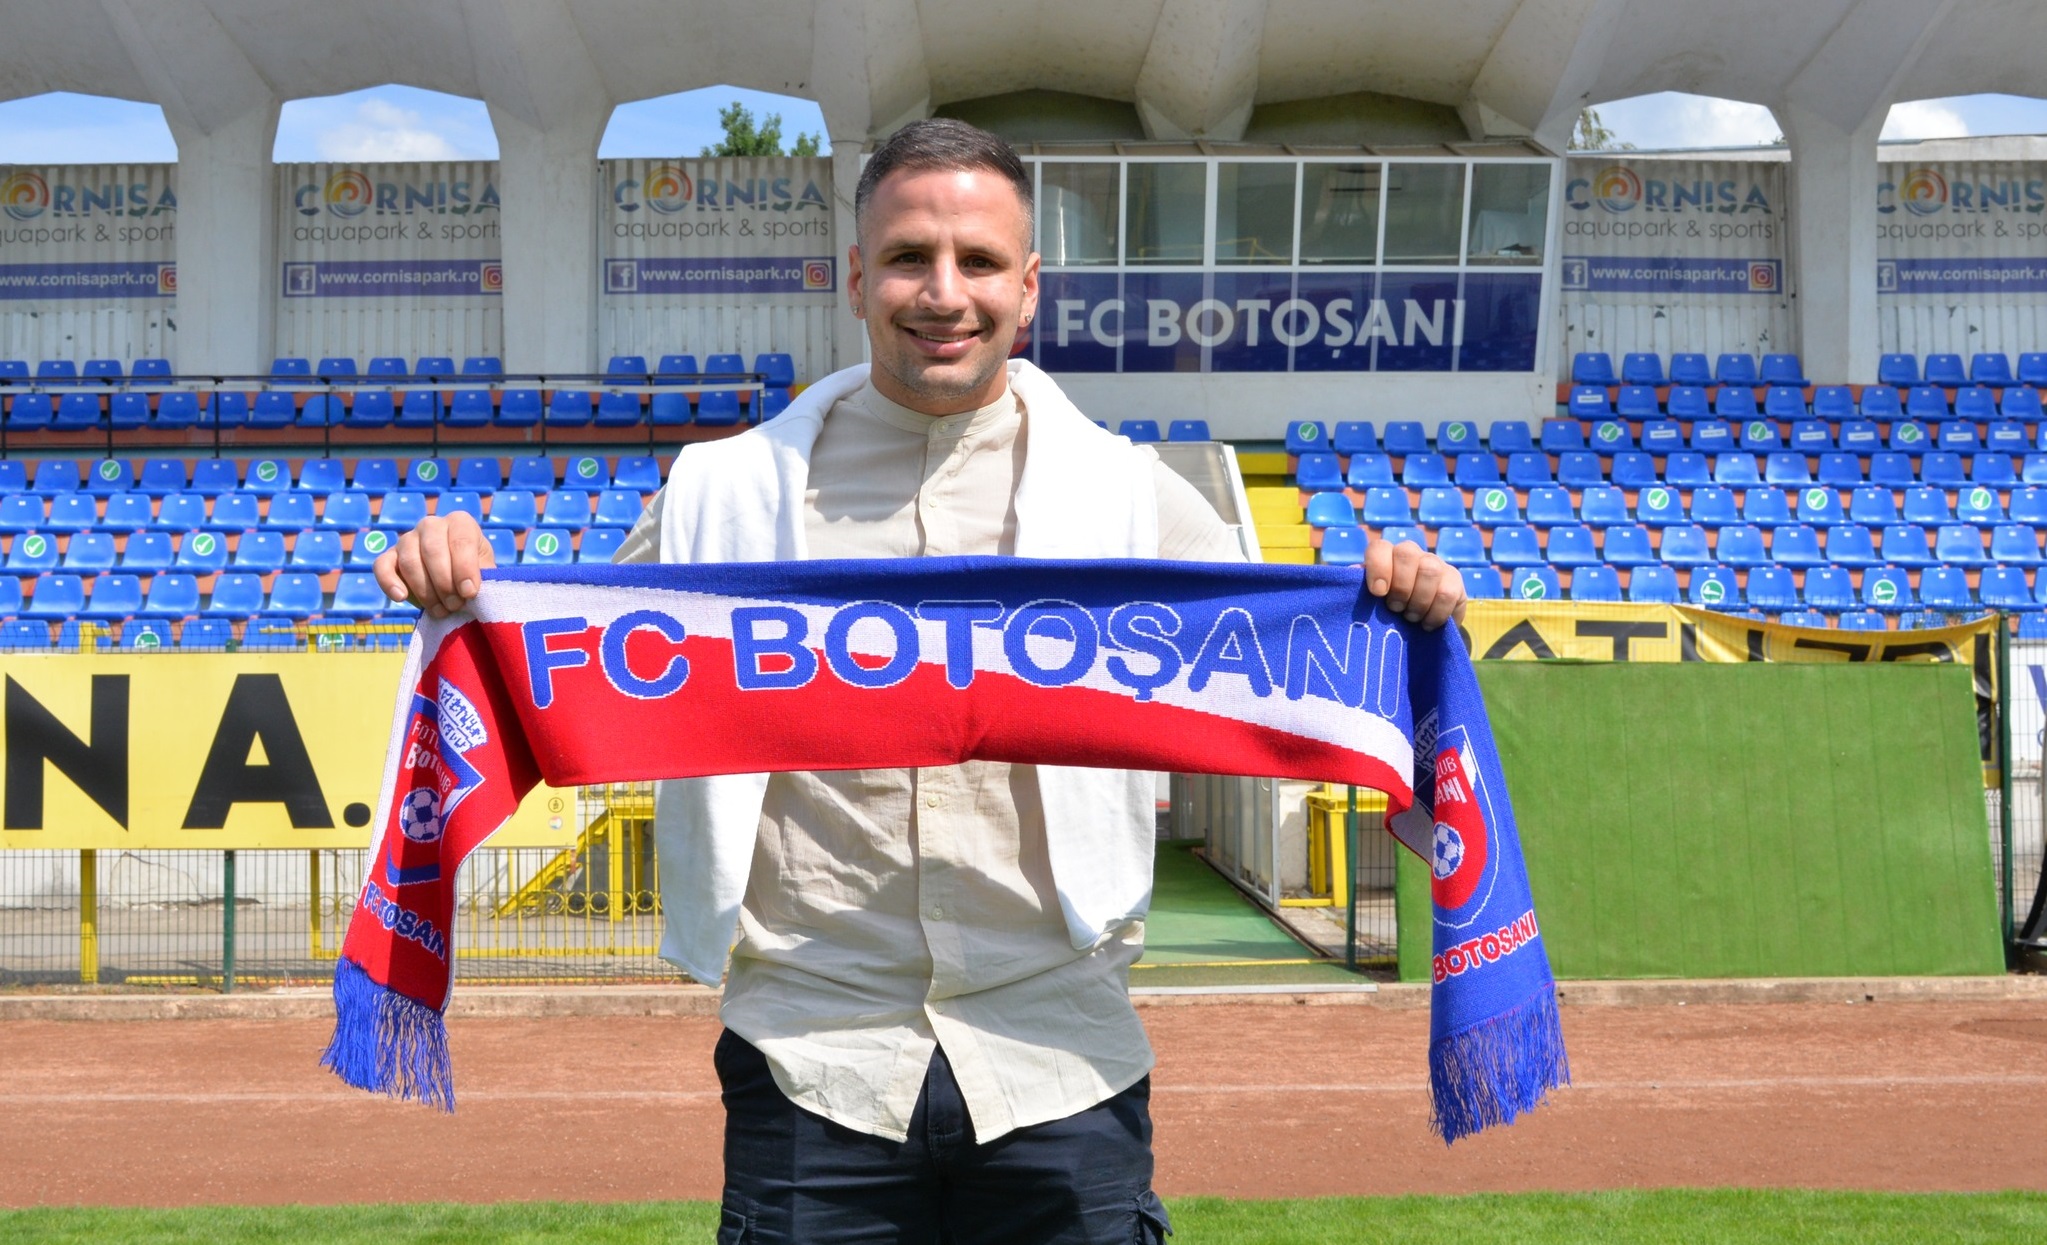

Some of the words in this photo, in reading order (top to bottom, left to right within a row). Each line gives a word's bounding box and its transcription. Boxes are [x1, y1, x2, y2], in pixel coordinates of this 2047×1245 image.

[94, 224, 110, 243] &
[119, 223, 176, 246] sport
[294, 221, 409, 245] aquapark
[417, 221, 433, 240] &
[614, 217, 730, 241] aquapark
[738, 218, 755, 236] &
[763, 217, 828, 240] sports
[1565, 218, 1678, 240] aquapark
[1686, 219, 1701, 238] &
[1709, 219, 1773, 241] sports
[1877, 219, 1986, 242] aquapark
[1994, 219, 2008, 237] &
[320, 269, 479, 286] www.cornisapark.ro
[641, 266, 801, 283] www.cornisapark.ro
[1592, 266, 1747, 283] www.cornisapark.ro
[1056, 299, 1125, 347] FC
[521, 609, 690, 710] FC
[729, 598, 1404, 719] BOTOȘANI
[1433, 908, 1540, 985] BOTOSANI
